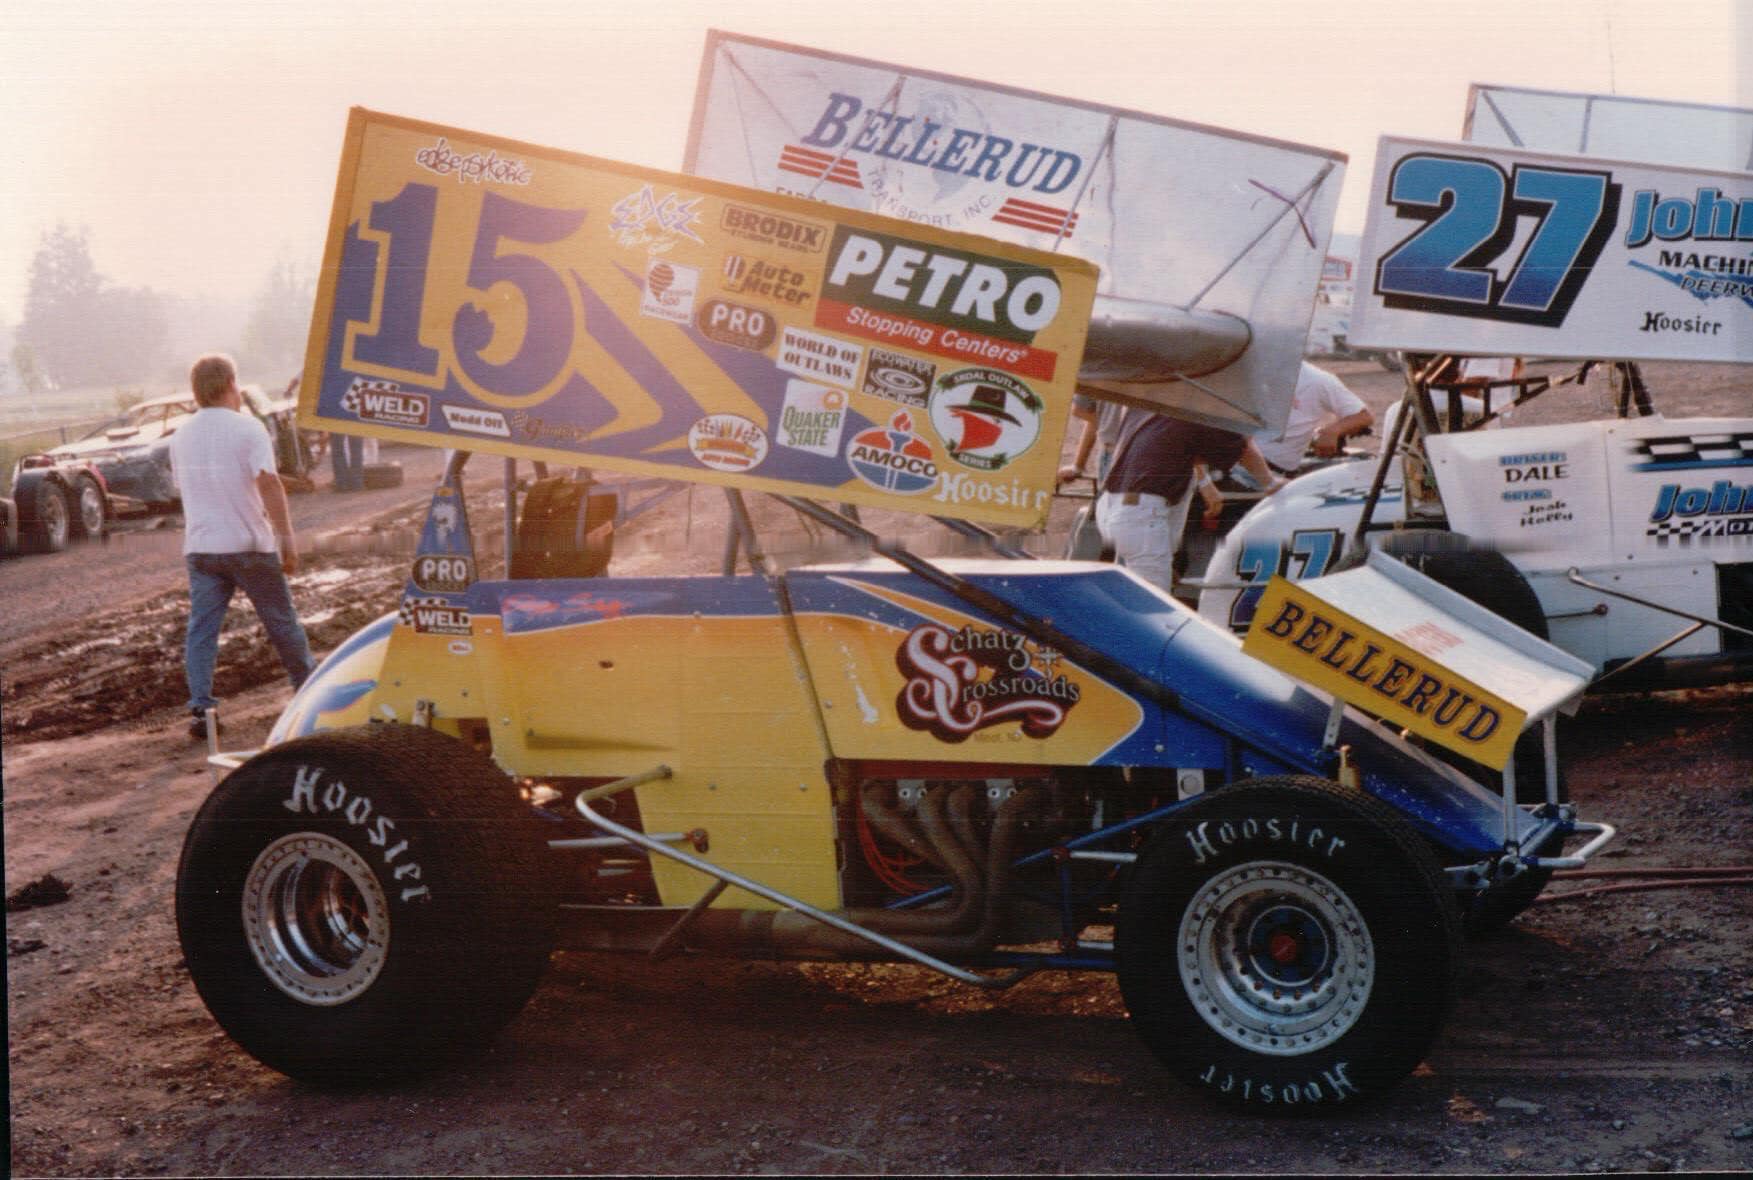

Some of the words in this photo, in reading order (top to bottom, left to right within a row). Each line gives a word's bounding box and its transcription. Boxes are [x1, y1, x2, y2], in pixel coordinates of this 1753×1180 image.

[802, 92, 1082, 194] BELLERUD
[726, 207, 820, 246] BRODIX
[1374, 152, 1622, 328] 27
[750, 260, 804, 287] Auto
[1659, 250, 1753, 276] MACHI
[352, 181, 589, 400] 15
[742, 275, 811, 304] Meter
[828, 234, 1062, 332] PETRO
[711, 303, 766, 336] PRO
[846, 305, 935, 346] Stopping
[1639, 311, 1723, 335] Hoosier
[784, 333, 838, 357] WORLD
[840, 350, 858, 365] OF
[783, 351, 855, 381] OUTLAWS
[363, 393, 425, 417] WELD
[783, 405, 841, 431] QUAKER
[786, 428, 829, 448] STATE
[851, 446, 938, 478] AMOCO
[1504, 464, 1571, 483] DALE
[932, 471, 1047, 510] Hoosier
[423, 559, 467, 580] PRO
[1228, 528, 1345, 632] 27
[417, 610, 472, 628] WELD
[1265, 600, 1500, 743] BELLERUD
[907, 655, 1081, 729] Crossroads
[283, 765, 429, 901] Hoosier
[1185, 818, 1347, 864] Hoosier
[1200, 1062, 1358, 1104] Hoosier
